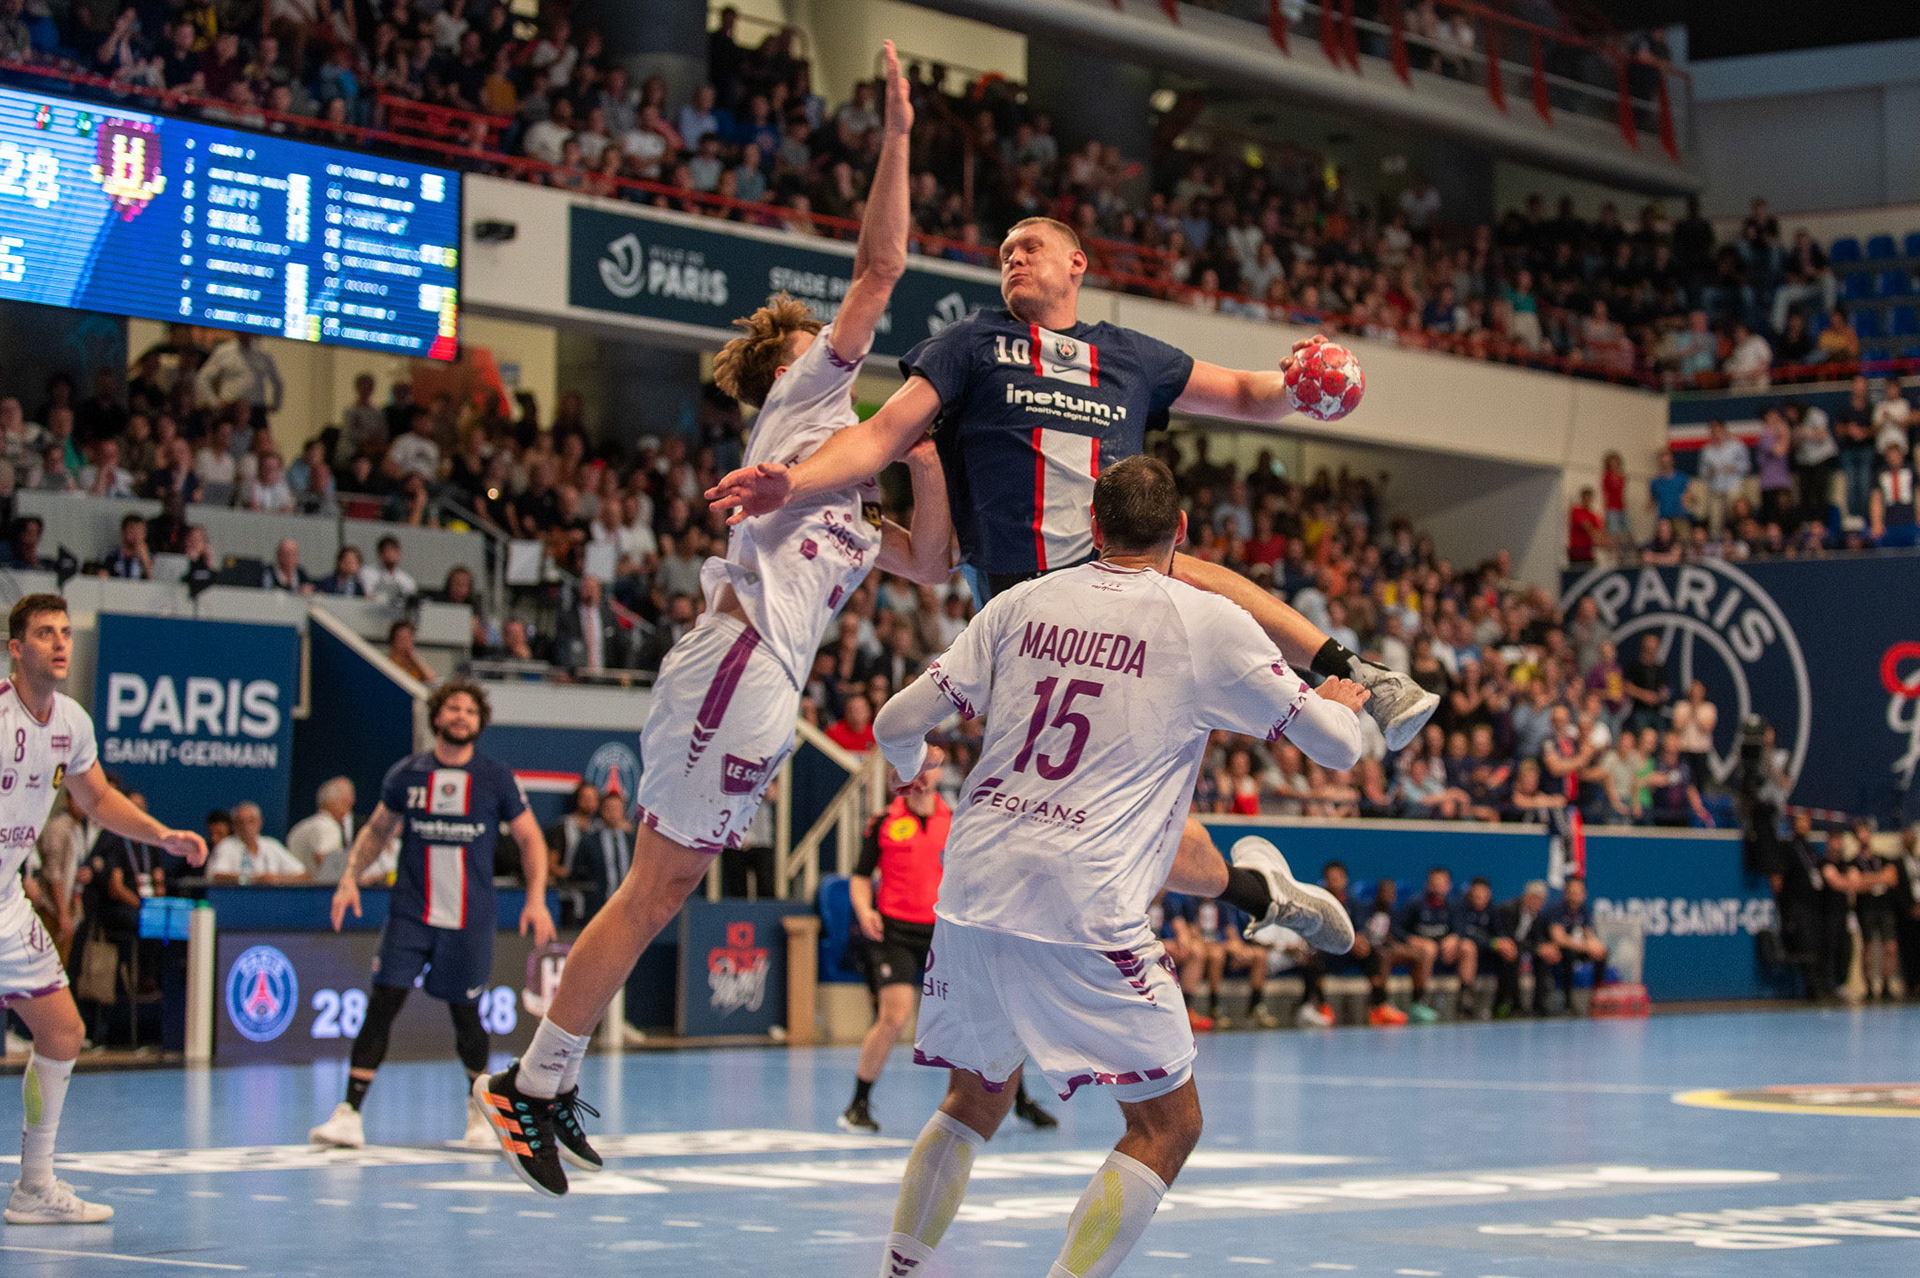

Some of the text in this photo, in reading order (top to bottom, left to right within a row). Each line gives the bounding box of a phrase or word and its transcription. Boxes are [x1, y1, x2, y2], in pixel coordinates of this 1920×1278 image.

[648, 260, 729, 306] PARIS
[995, 335, 1031, 365] 10
[1025, 405, 1062, 417] positive
[1063, 411, 1090, 423] digital
[1592, 566, 1776, 663] PARIS
[1019, 621, 1147, 678] MAQUEDA
[106, 672, 280, 738] PARIS
[14, 727, 26, 763] 8
[1013, 676, 1103, 781] 15
[104, 738, 279, 768] SAINT-GERMAIN
[726, 762, 744, 780] LE
[712, 809, 731, 838] 3
[311, 988, 369, 1039] 28
